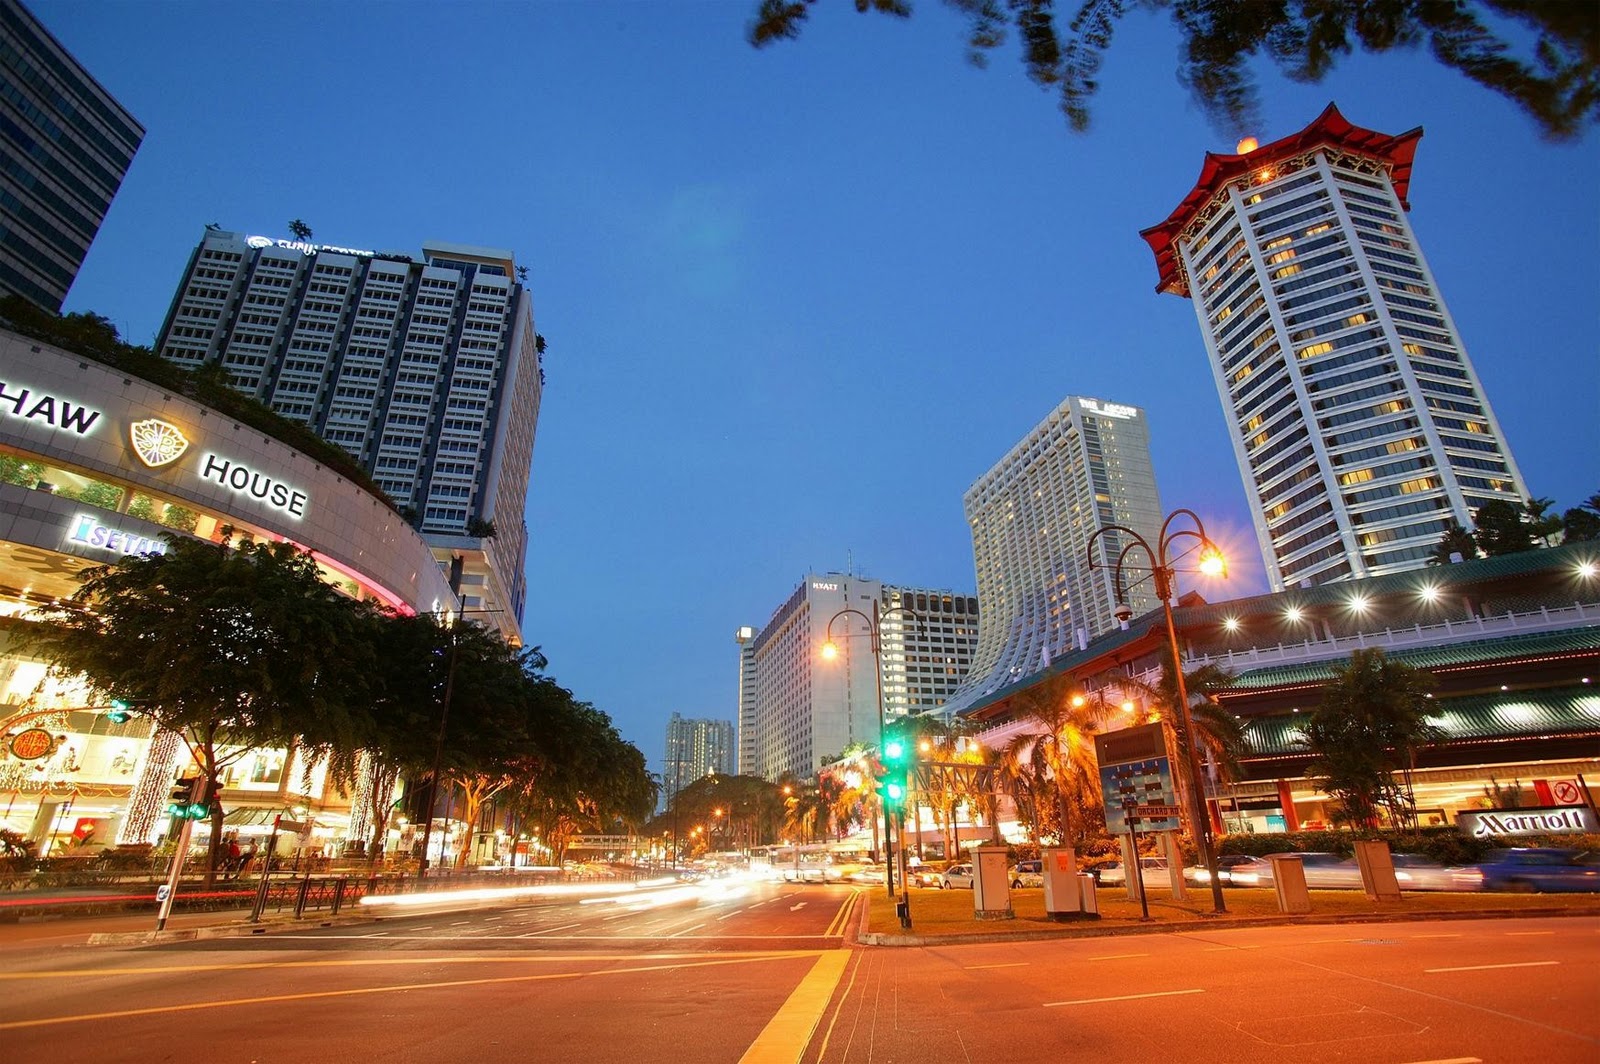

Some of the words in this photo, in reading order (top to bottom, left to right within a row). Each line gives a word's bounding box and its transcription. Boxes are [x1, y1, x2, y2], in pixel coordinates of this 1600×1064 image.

[203, 454, 307, 517] HOUSE
[812, 582, 838, 591] HYATT
[1137, 807, 1168, 816] ORCHARD
[1170, 807, 1179, 815] RD
[1475, 811, 1583, 835] Marriott
